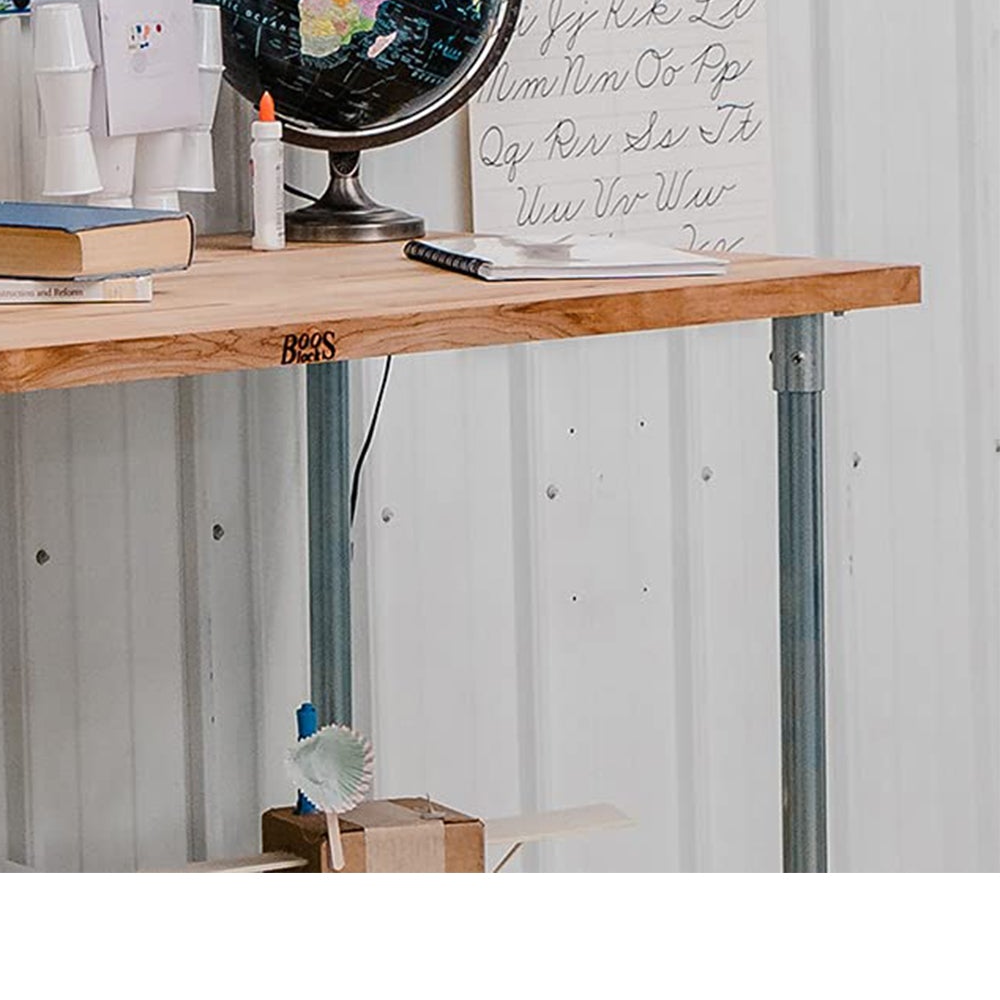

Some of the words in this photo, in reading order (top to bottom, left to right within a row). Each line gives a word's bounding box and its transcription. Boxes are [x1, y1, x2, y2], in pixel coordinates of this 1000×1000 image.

[635, 48, 684, 88] Oo
[690, 42, 753, 100] Pp
[53, 287, 83, 298] Reform
